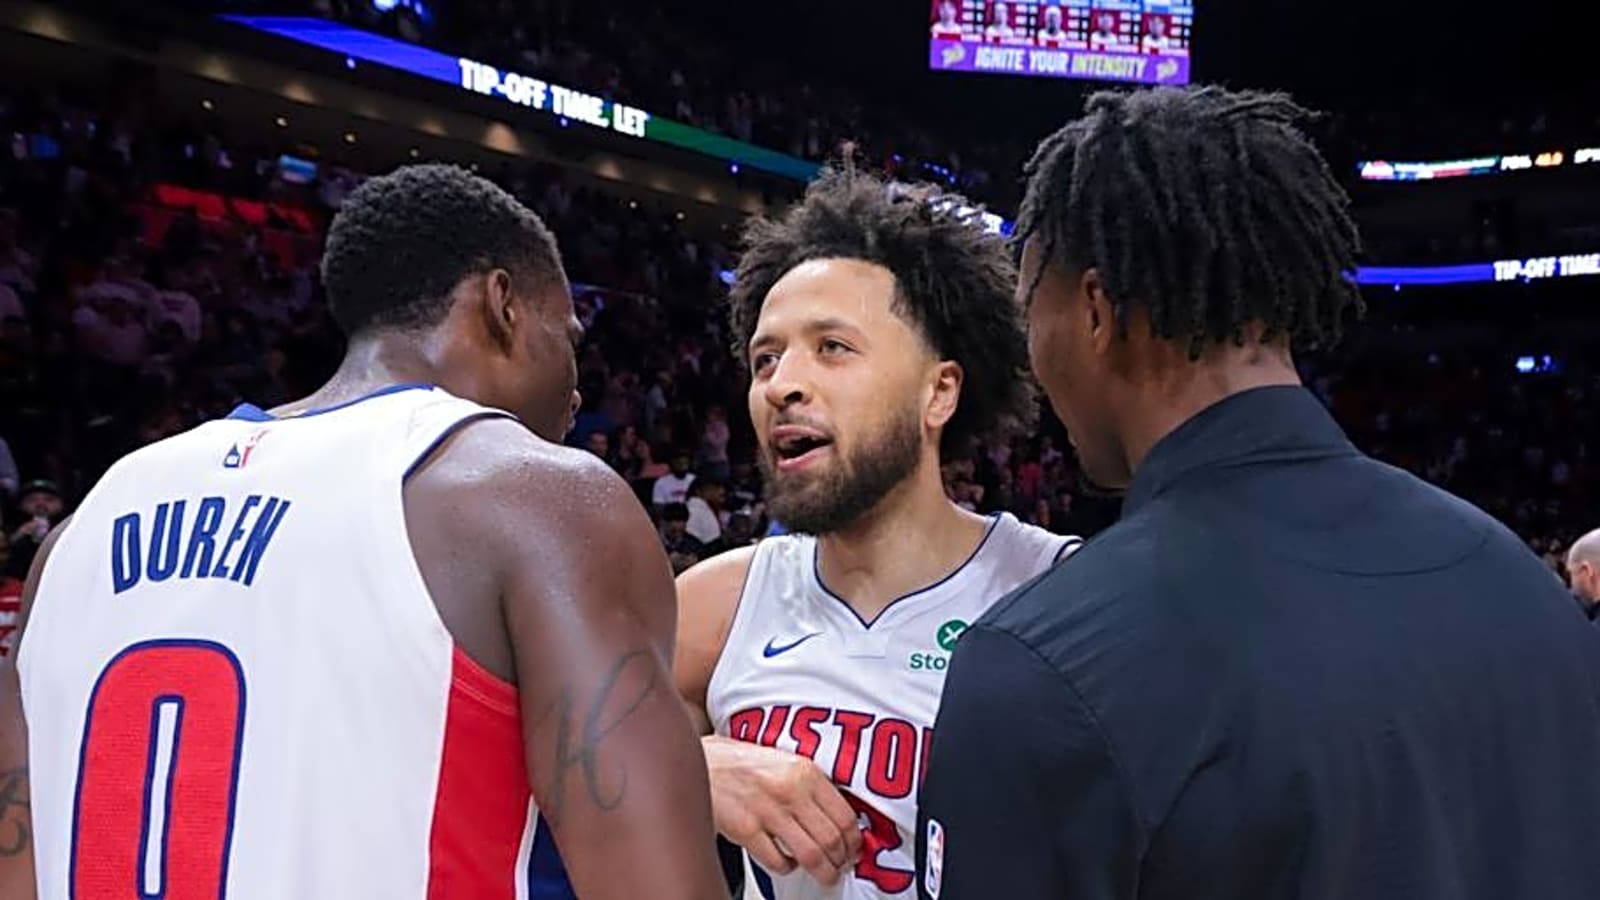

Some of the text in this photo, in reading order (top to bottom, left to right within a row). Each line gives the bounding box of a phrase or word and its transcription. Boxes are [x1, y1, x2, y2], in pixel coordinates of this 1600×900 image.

[459, 57, 547, 109] TIP-OFF
[613, 103, 648, 137] LET
[975, 46, 1147, 80] IGNITE YOUR INTENSITY
[1493, 257, 1557, 281] TIP-OFF
[111, 495, 291, 595] DUREN
[69, 639, 247, 900] 0
